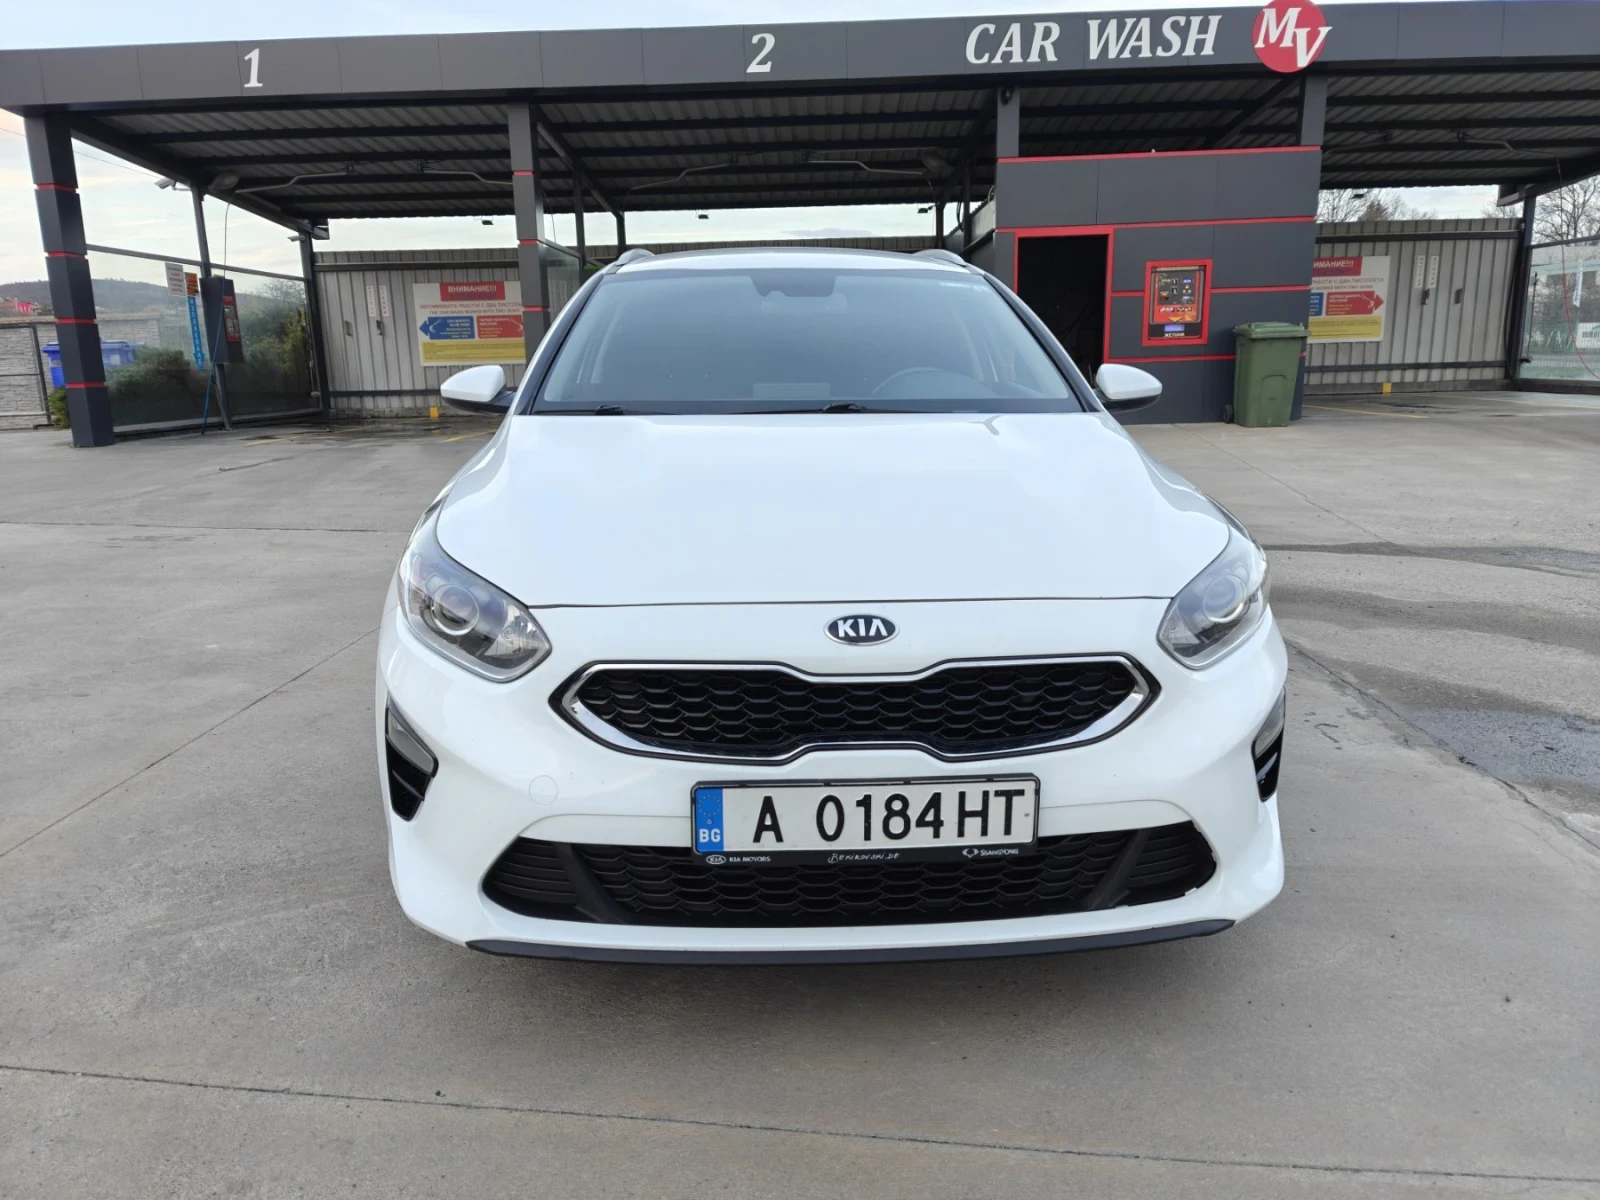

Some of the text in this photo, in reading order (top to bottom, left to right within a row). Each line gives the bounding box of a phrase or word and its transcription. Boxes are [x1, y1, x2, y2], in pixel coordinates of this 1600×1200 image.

[746, 32, 776, 73] 2
[965, 14, 1222, 64] CAR WASH
[244, 47, 263, 88] 1
[837, 618, 888, 637] KIA
[699, 828, 721, 843] BG
[752, 795, 785, 843] A
[980, 848, 1019, 857] SSANGYONG
